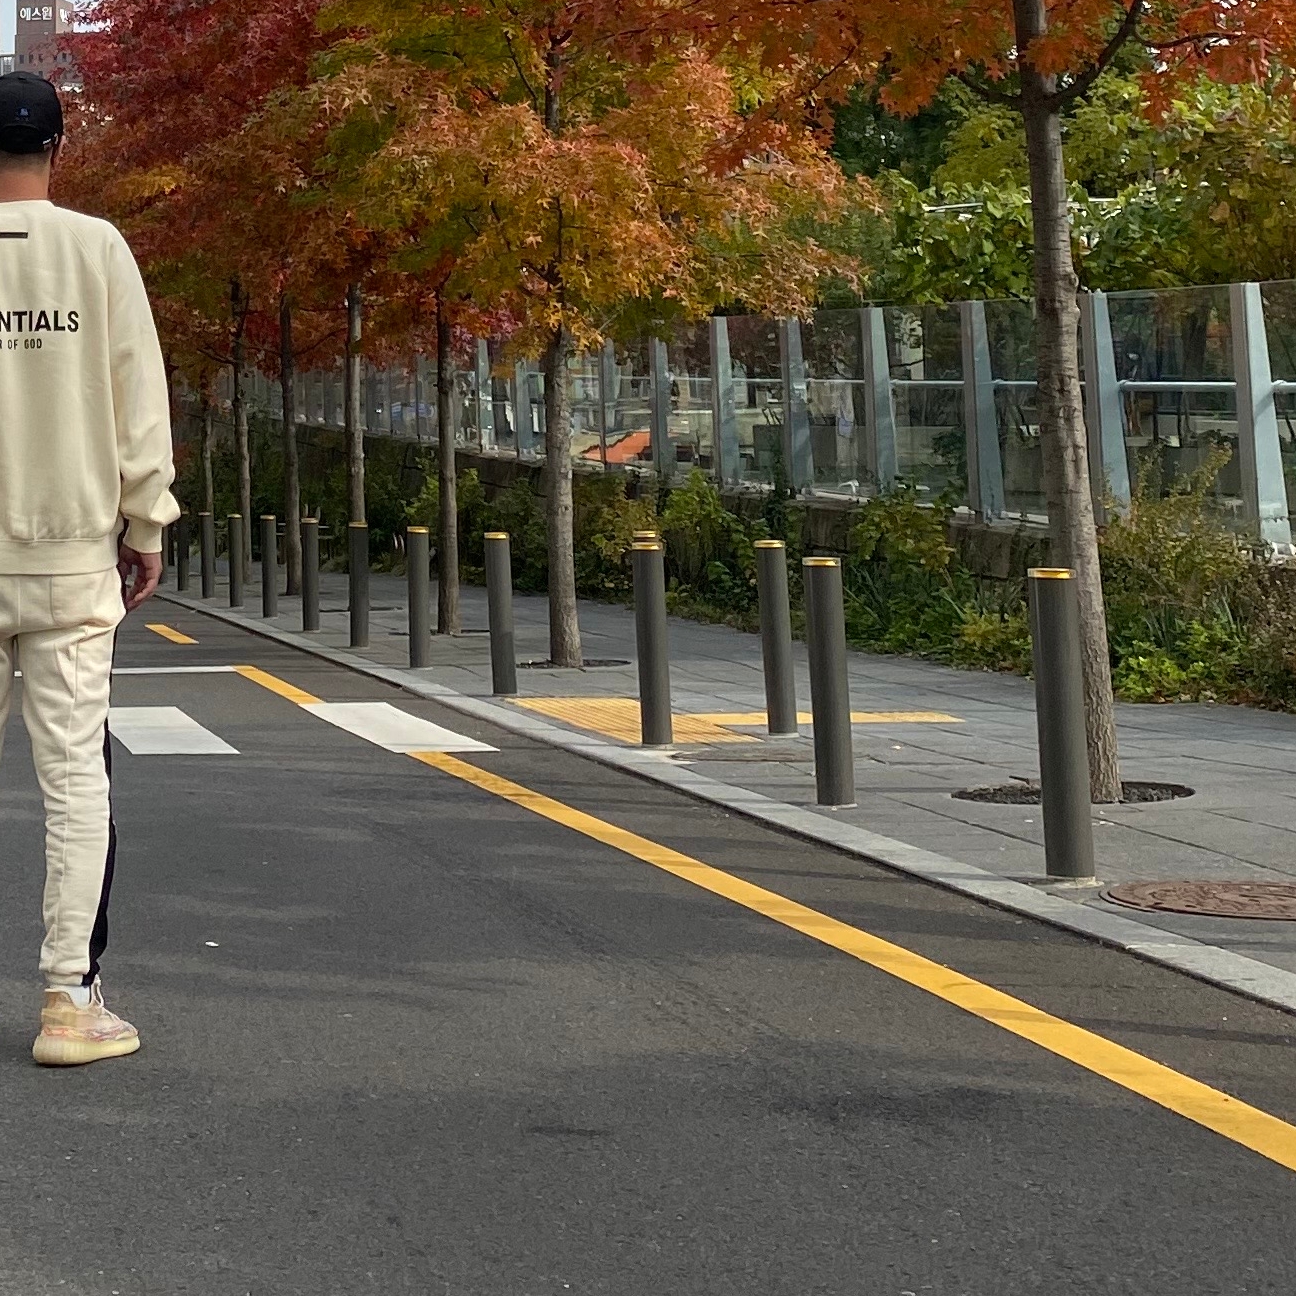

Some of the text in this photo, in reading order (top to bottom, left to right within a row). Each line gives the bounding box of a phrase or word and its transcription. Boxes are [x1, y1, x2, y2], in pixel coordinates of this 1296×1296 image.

[20, 6, 52, 21] 에스원
[7, 339, 18, 350] OF
[24, 338, 43, 349] GOD
